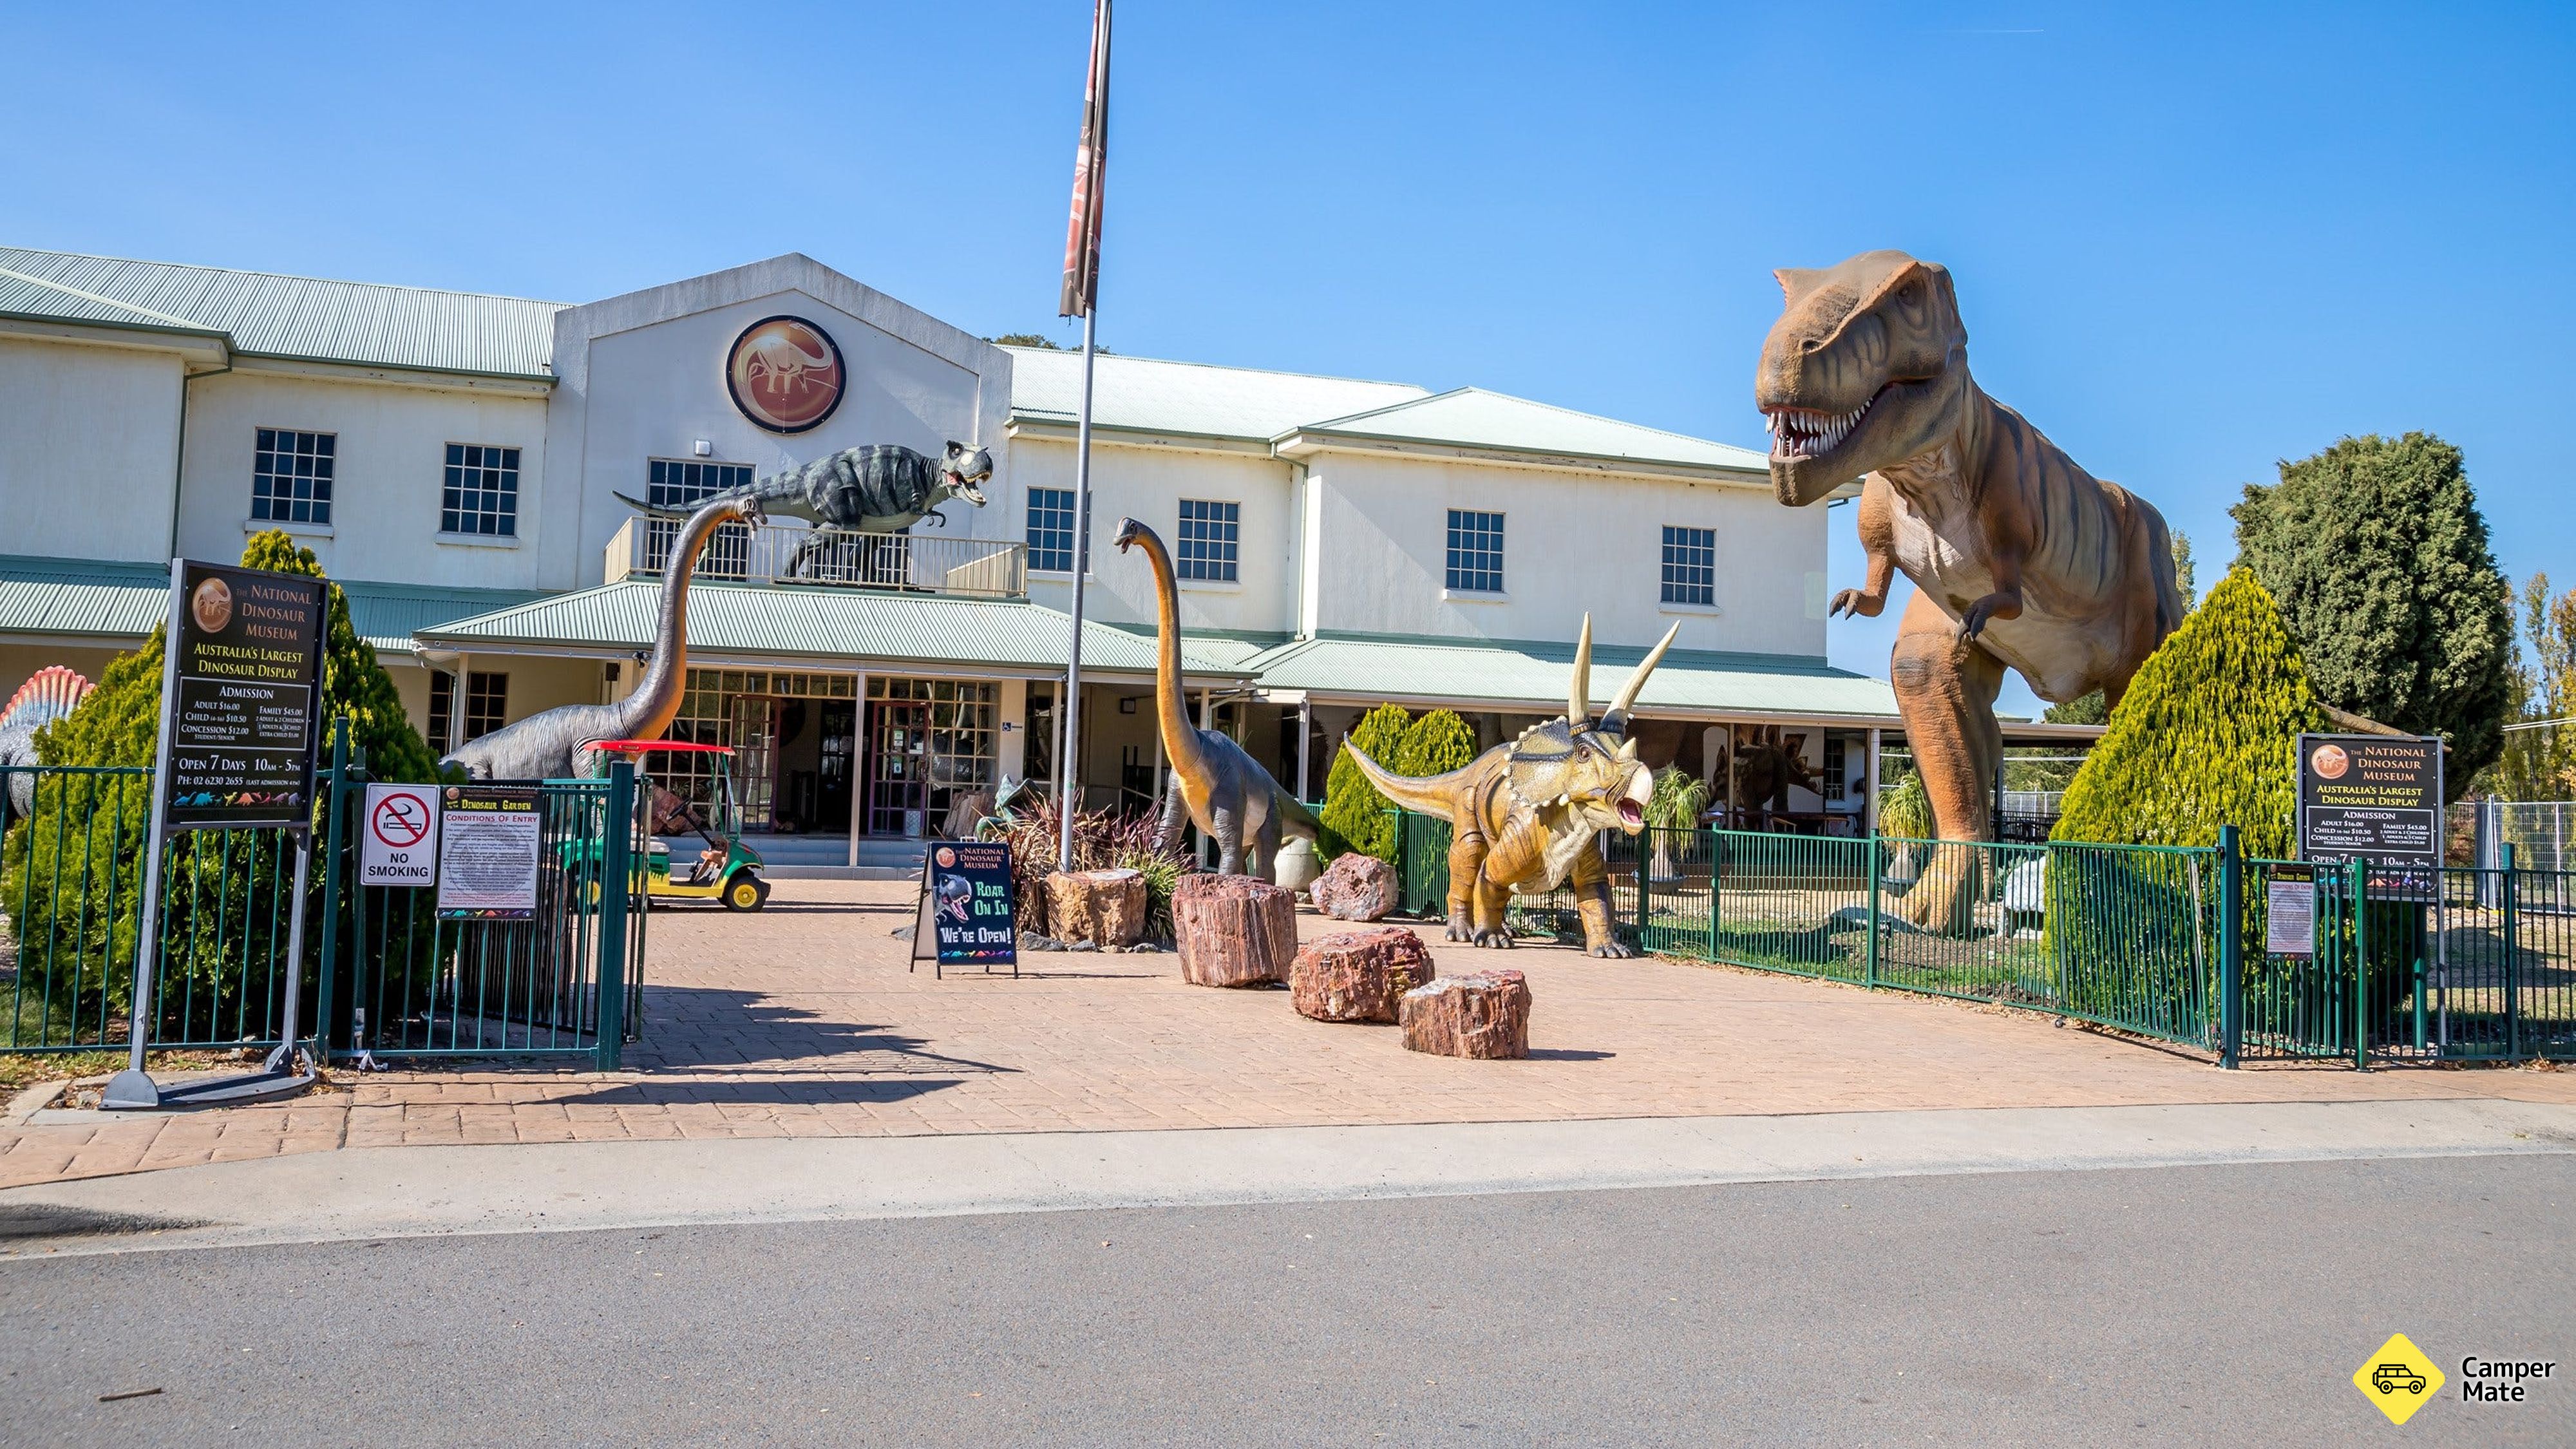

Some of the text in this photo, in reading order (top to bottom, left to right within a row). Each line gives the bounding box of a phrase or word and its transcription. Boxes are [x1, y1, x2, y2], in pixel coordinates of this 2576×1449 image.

[251, 585, 312, 605] NATIONAL
[242, 603, 305, 622] DINOSAUR
[246, 623, 298, 640] MUSEUM
[194, 642, 303, 663] AUSTRALIA'S LARGEST
[198, 660, 298, 679] DINOSAUR DISPLAY
[219, 686, 274, 699] ADMISSION
[194, 700, 240, 710] ADULT $16.00
[260, 706, 303, 715] FAMILY $45.00
[185, 712, 209, 721] CHILD
[226, 714, 247, 723] $10.50
[181, 724, 249, 734] CONCESSION $12.00
[2365, 746, 2427, 757] NATIONAL
[179, 758, 207, 770] OPEN
[211, 754, 220, 770] 7
[222, 759, 246, 770] DAYS
[255, 759, 276, 771] 10AM
[285, 759, 300, 772] 5PM
[2358, 759, 2421, 770] DINOSAUR
[177, 775, 192, 784] PH:
[193, 776, 204, 785] 02
[205, 777, 223, 785] 6230
[225, 777, 243, 785] 2655
[2363, 772, 2415, 781] MUSEUM
[2316, 784, 2423, 796] AUSTRALIA'S LARGEST
[462, 799, 497, 810] DINOSAUR
[502, 800, 531, 810] GARDEN
[2322, 795, 2419, 806] DINOSAUR DISPLAY
[2344, 811, 2395, 820] ADMISSION
[390, 853, 408, 863] NO
[2340, 853, 2348, 864] 7
[2383, 857, 2405, 866] 10AM
[368, 866, 428, 876] SMOKING
[975, 882, 1005, 897] ROAR
[974, 900, 1009, 915] ON IN
[940, 927, 1011, 944] WE'RE OPEN!
